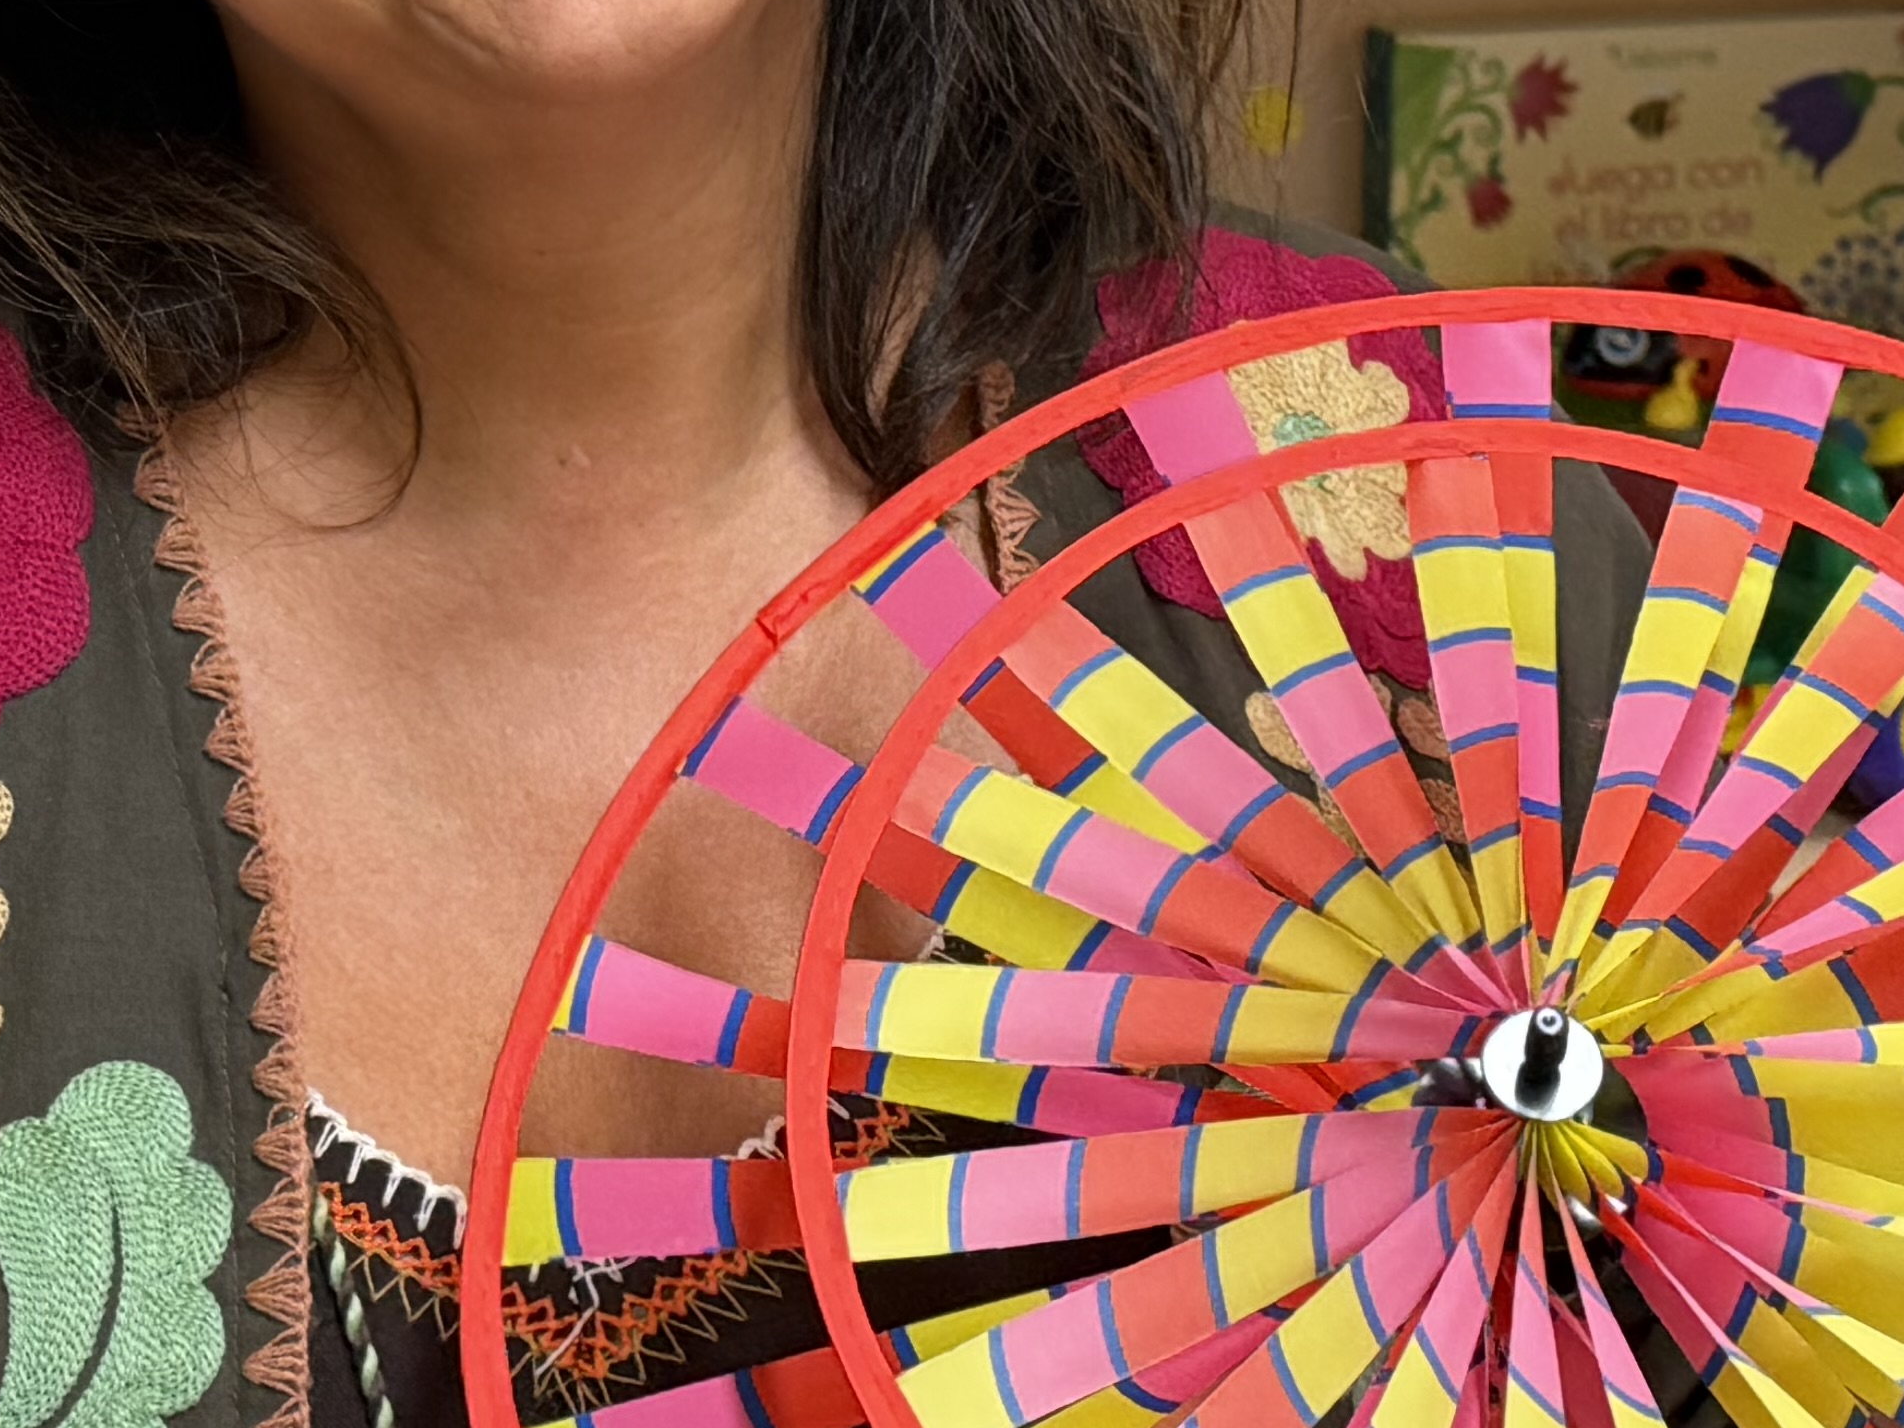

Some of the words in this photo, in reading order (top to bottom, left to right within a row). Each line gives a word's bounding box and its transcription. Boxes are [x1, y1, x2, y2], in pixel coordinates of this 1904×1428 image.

[1549, 155, 1675, 201] Juega
[1687, 156, 1765, 186] con
[1600, 208, 1689, 242] libro
[1700, 207, 1755, 239] de
